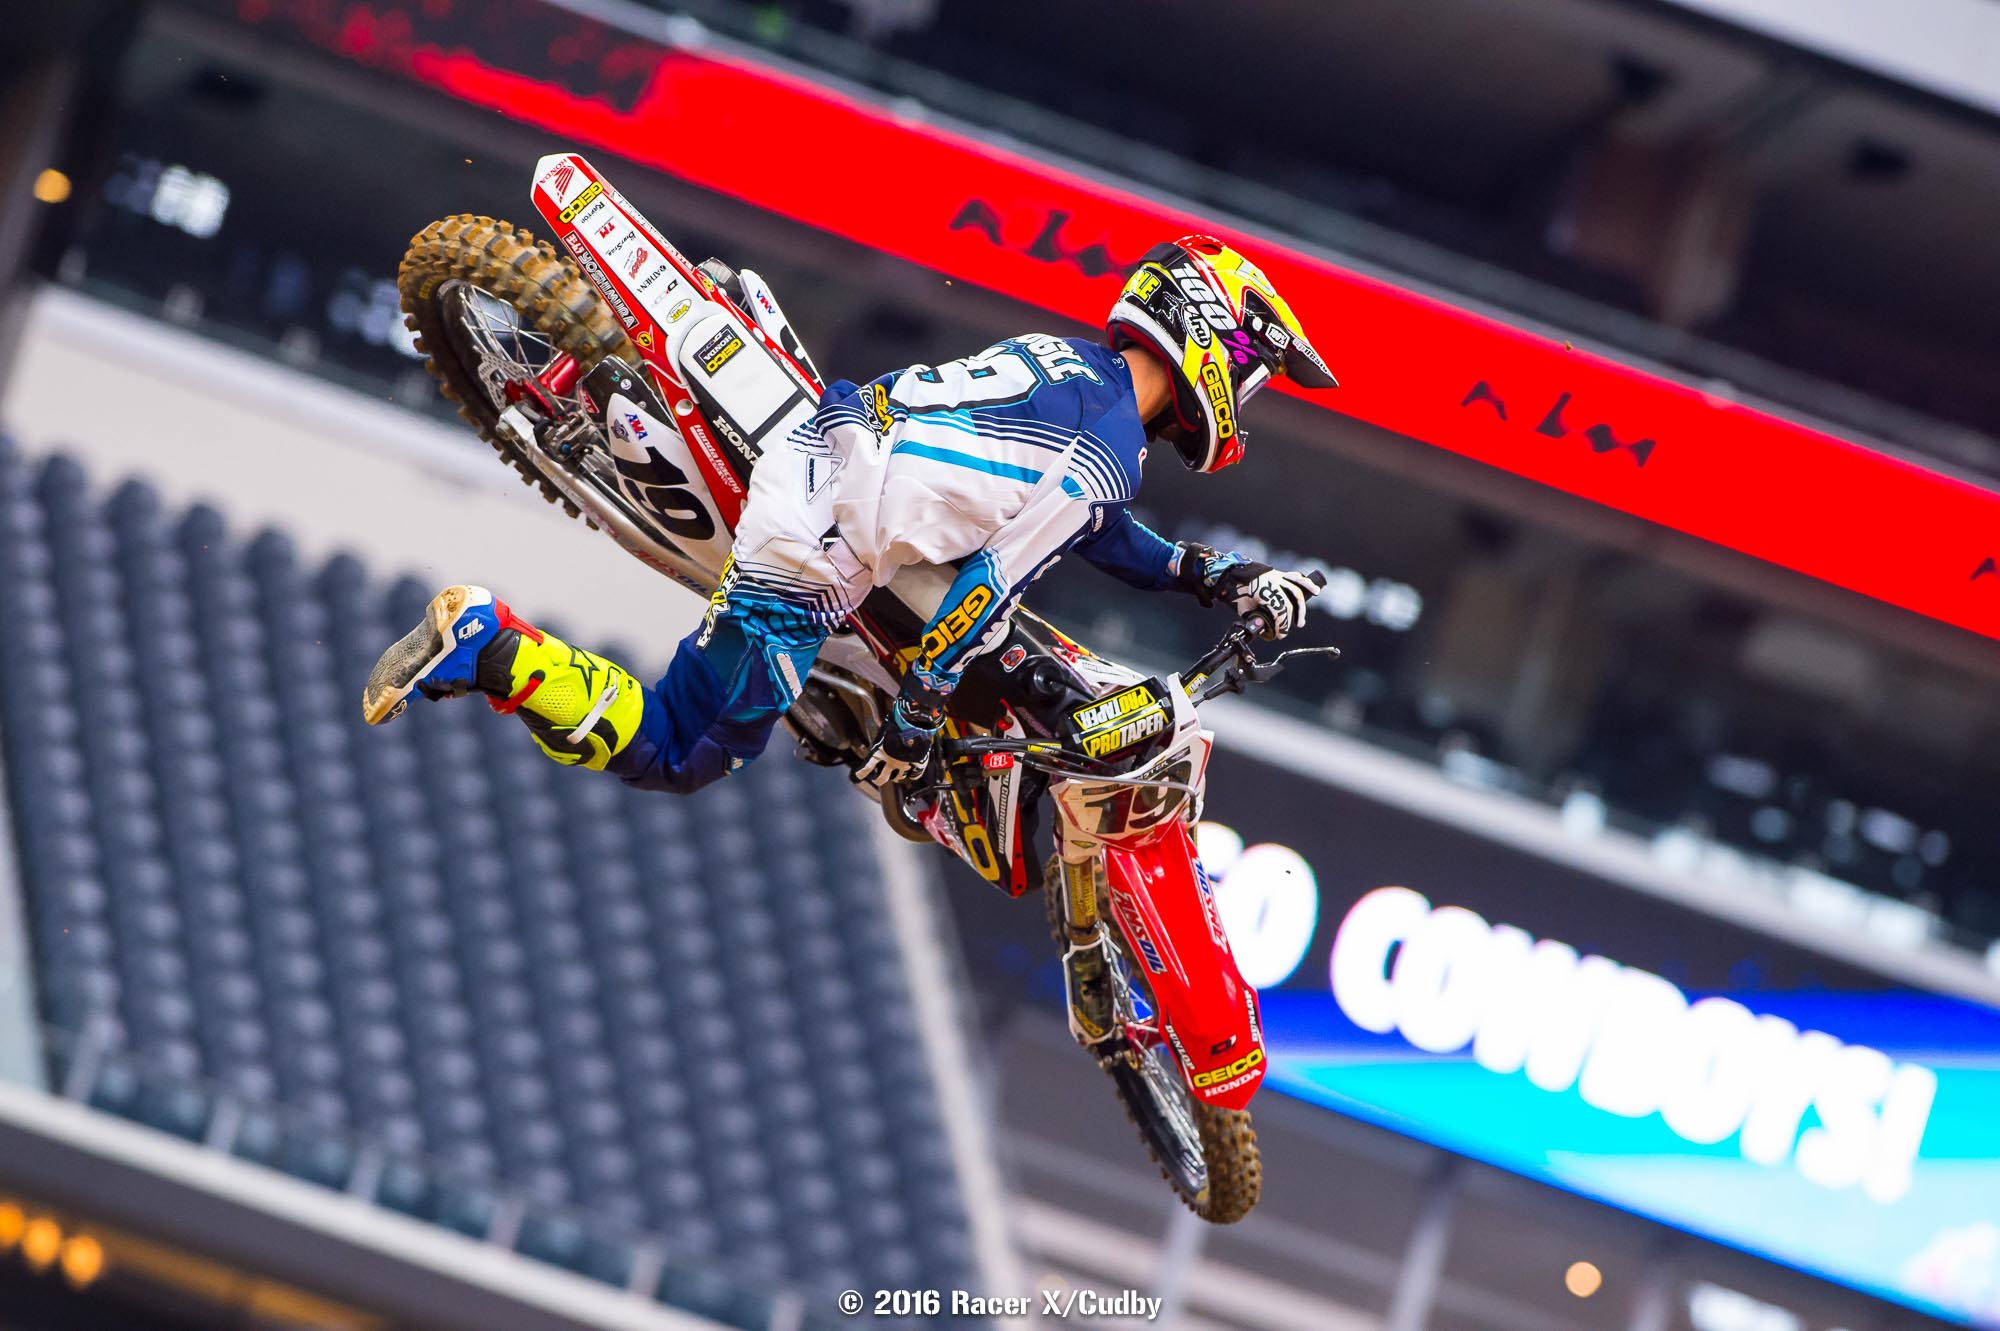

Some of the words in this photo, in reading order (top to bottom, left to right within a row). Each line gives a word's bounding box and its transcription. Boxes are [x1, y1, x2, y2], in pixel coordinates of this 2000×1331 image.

[540, 159, 567, 184] HONDA
[559, 181, 604, 224] GEICO
[599, 222, 615, 239] TM
[577, 251, 636, 329] YOSHIMURA
[637, 270, 661, 293] ATHENA
[1171, 262, 1258, 365] 100%
[1184, 304, 1211, 347] Arai
[1268, 327, 1288, 346] 100%
[703, 334, 733, 361] HONDA
[705, 338, 742, 373] GEICO
[1010, 334, 1101, 384] OGLE
[1200, 362, 1235, 439] GEICO
[624, 412, 648, 440] AMA
[713, 415, 759, 465] HON
[694, 424, 719, 459] Honda
[715, 459, 742, 494] Racing
[614, 446, 717, 541] 19
[1079, 689, 1148, 727] PROTAPER
[1092, 712, 1163, 757] PROTAPER
[998, 785, 1010, 854] Connection
[1084, 760, 1192, 834] 19
[1192, 858, 1226, 952] AMSOIL
[1112, 888, 1168, 972] AMSOIL
[1243, 989, 1259, 1043] DUNLOP
[1165, 1024, 1195, 1071] DUNLOP
[1193, 1048, 1263, 1088] GEICO
[1204, 1069, 1262, 1098] HONDA
